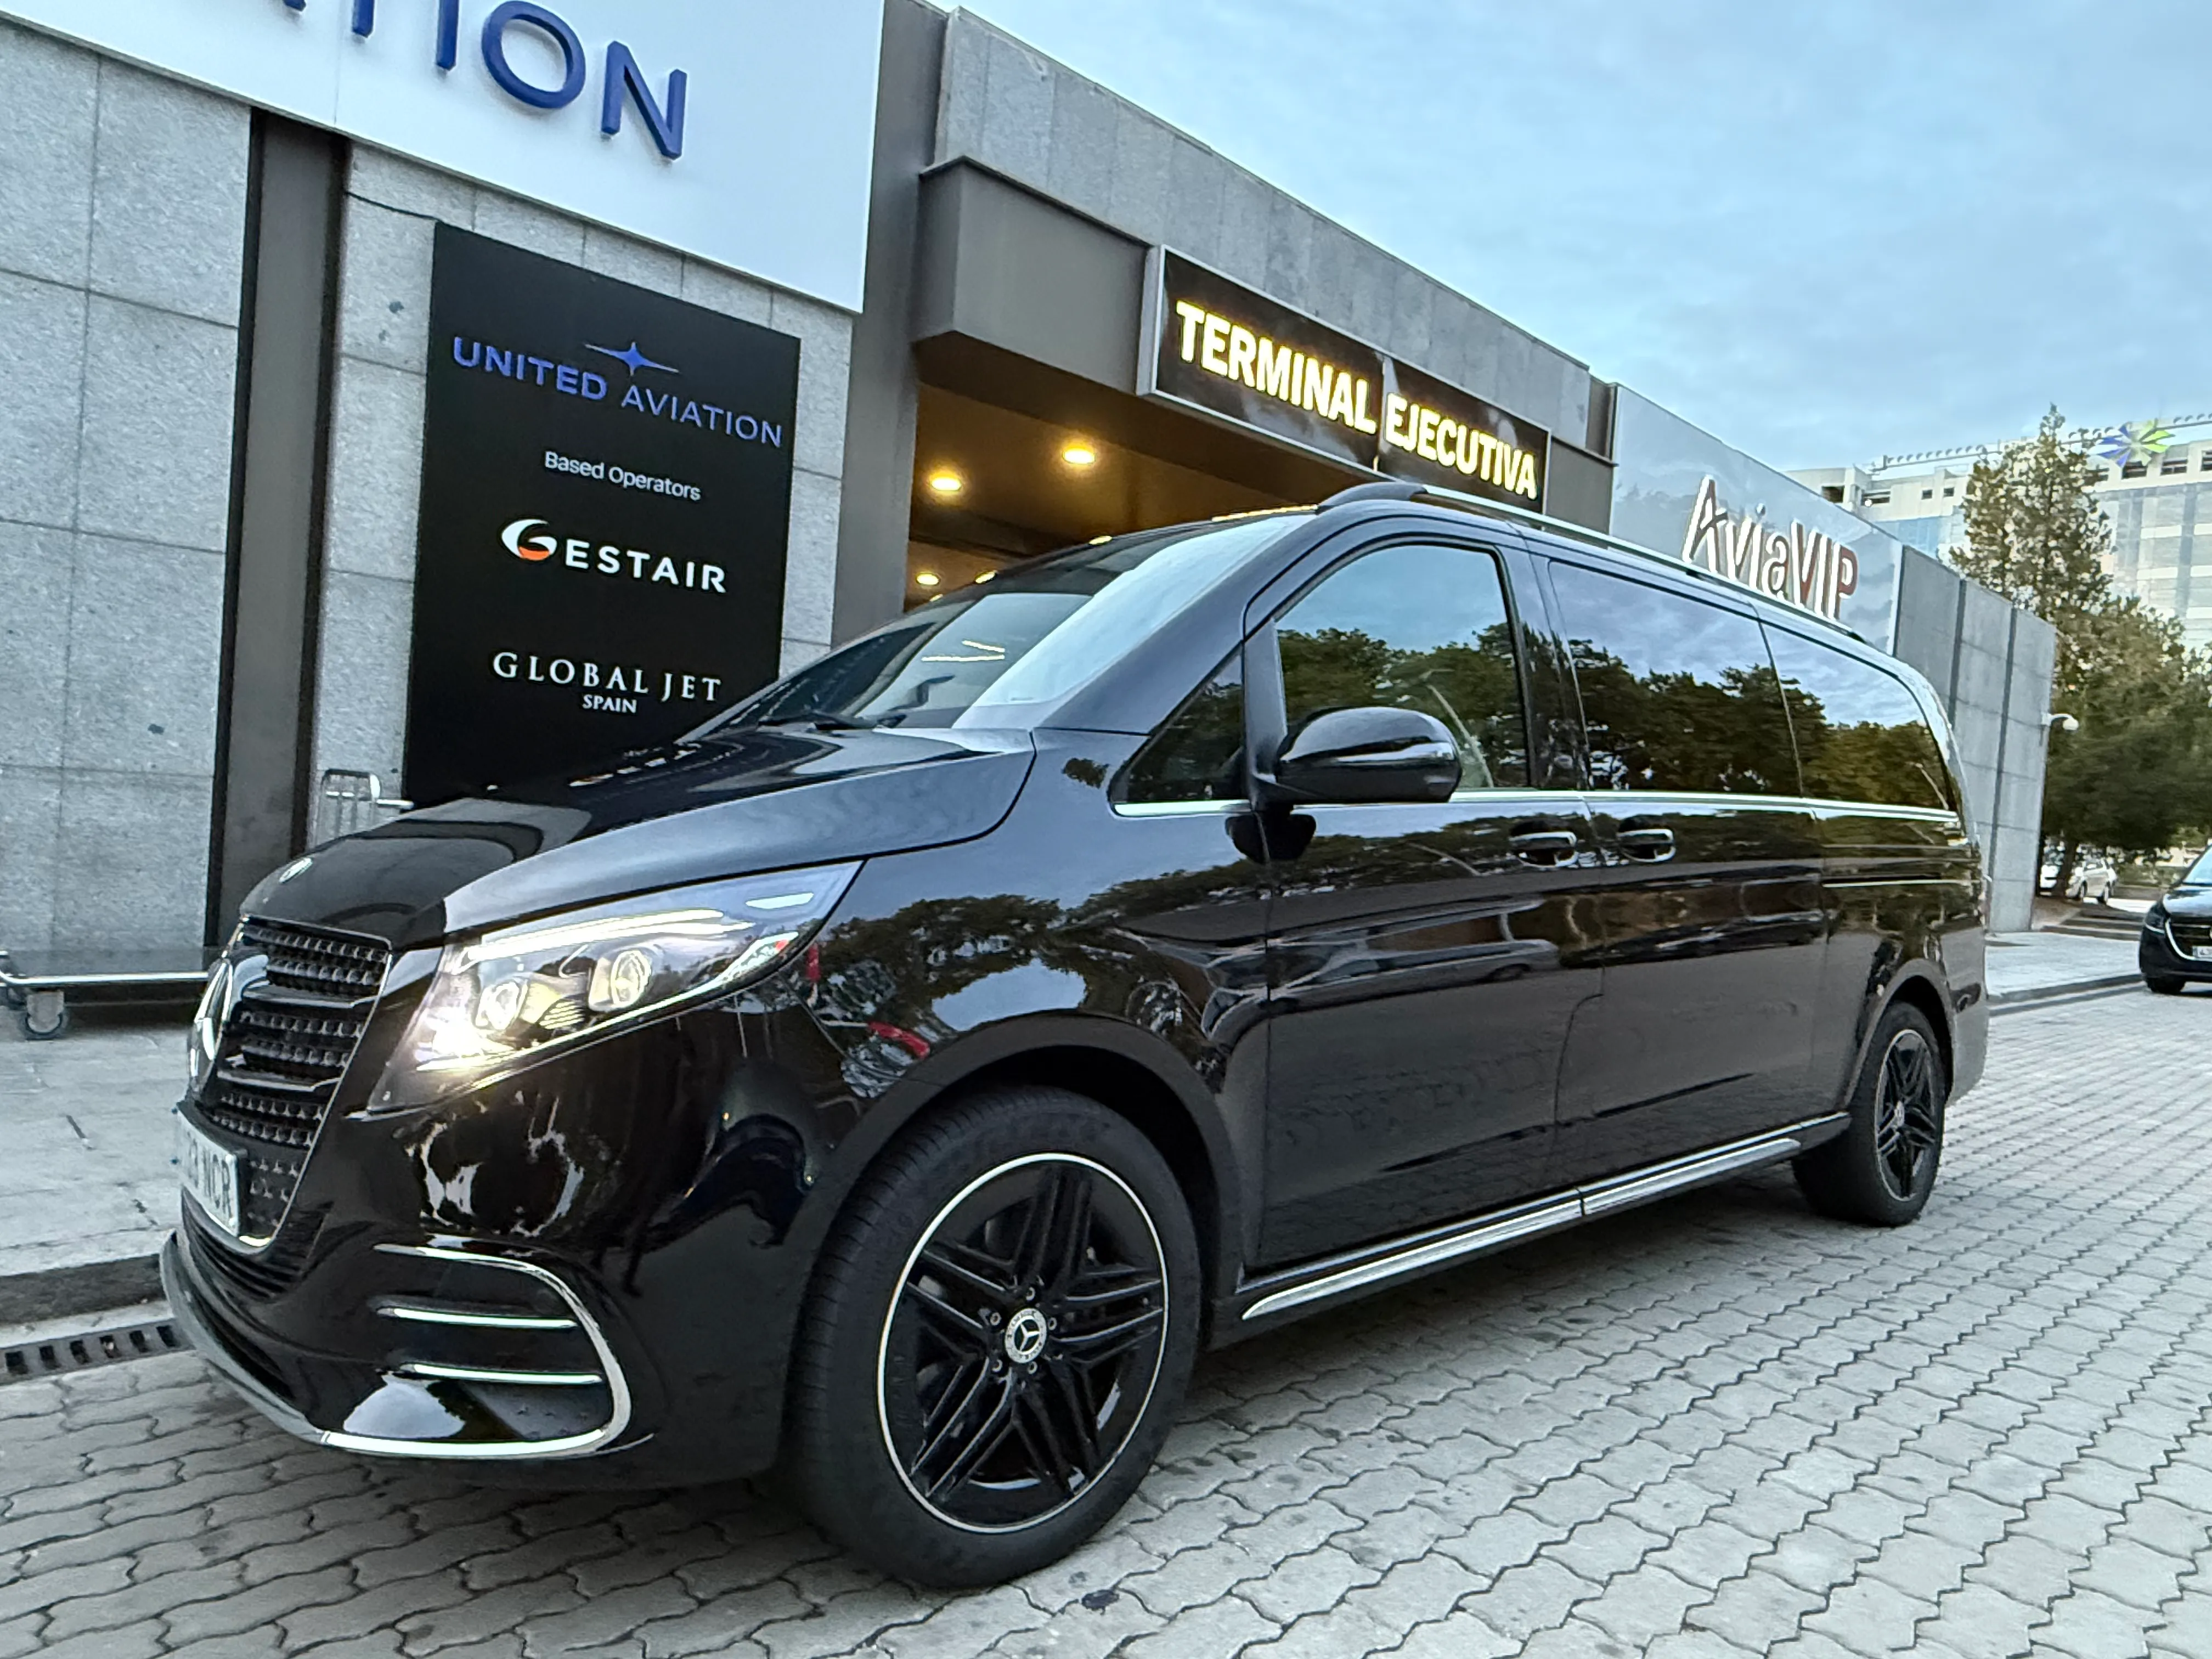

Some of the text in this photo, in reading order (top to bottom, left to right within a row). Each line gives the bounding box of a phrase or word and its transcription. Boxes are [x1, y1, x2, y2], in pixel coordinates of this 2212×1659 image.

[283, 0, 688, 160] ION
[453, 336, 782, 447] UNITED AVIATION
[1176, 300, 1538, 500] TERMINAL EJECUTIVA
[545, 450, 701, 501] Based Operators
[493, 652, 722, 702] GLOBAL JET
[582, 695, 637, 714] SPAIN
